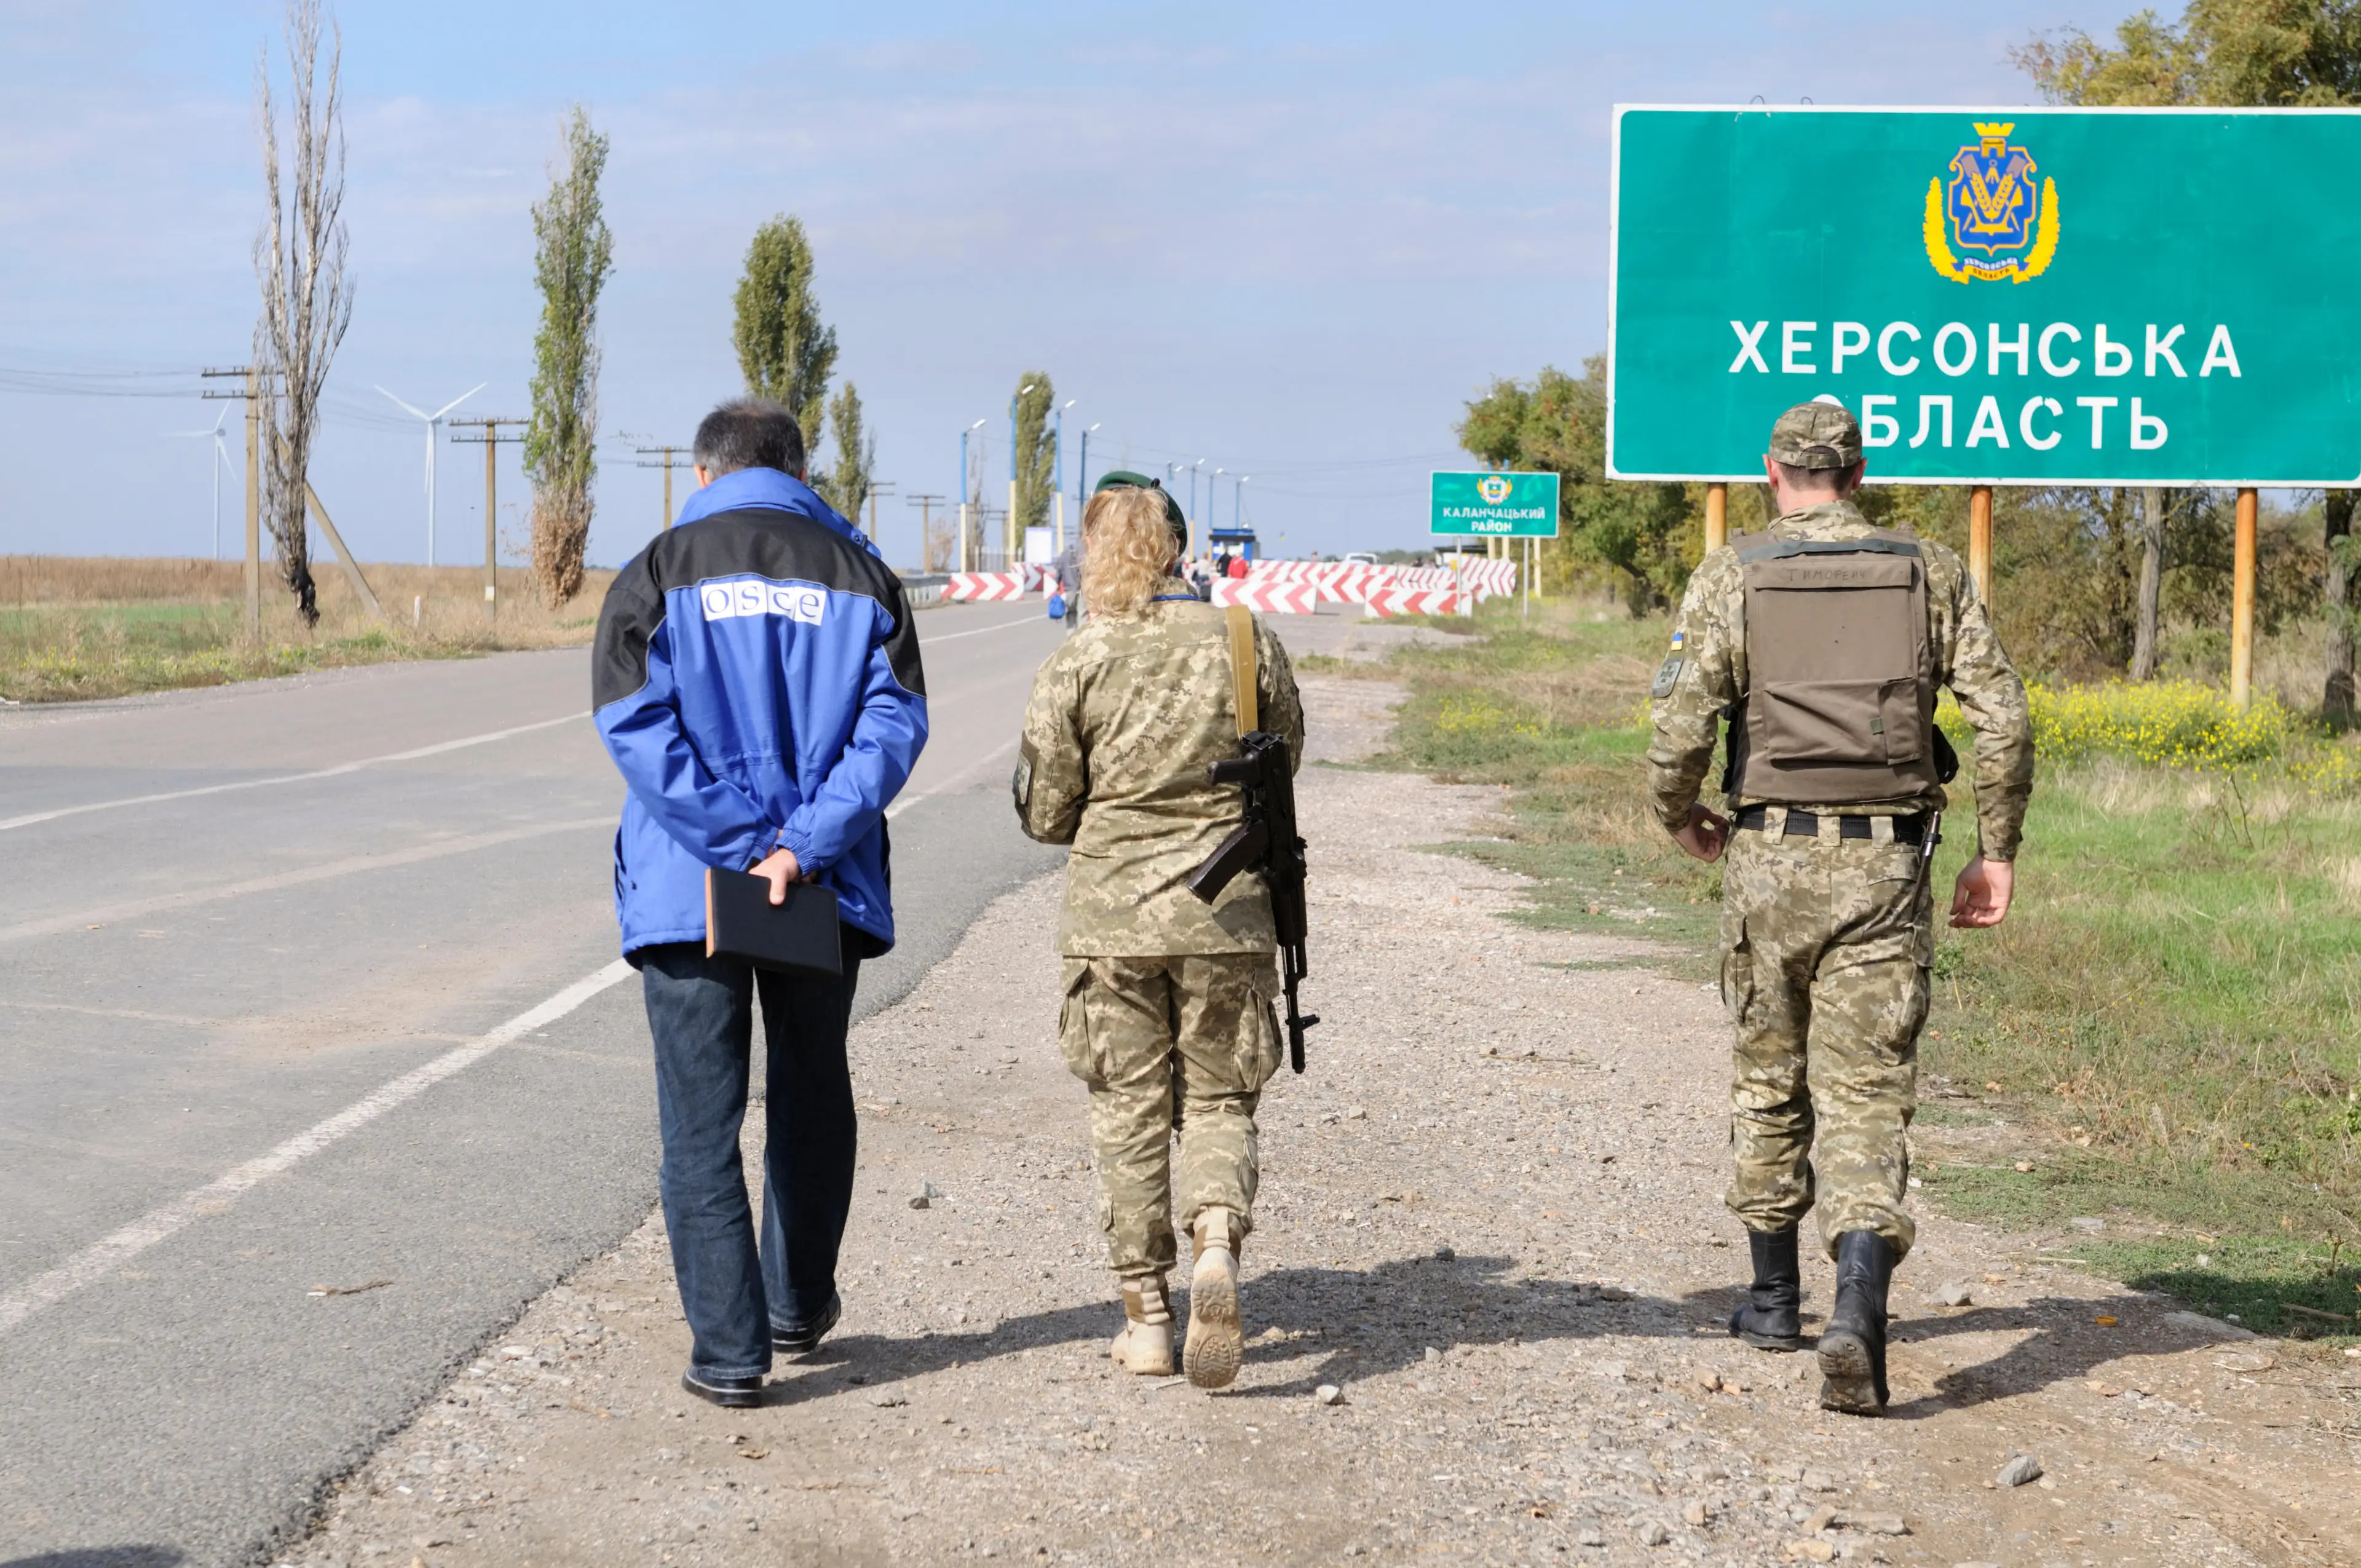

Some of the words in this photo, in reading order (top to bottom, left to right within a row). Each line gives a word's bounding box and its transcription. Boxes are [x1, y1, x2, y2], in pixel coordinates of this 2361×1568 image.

[1728, 320, 2242, 378] ХЕРСОНСЬКА
[1811, 394, 2168, 451] БЛАСТЬ
[1442, 506, 1545, 520] КАЛАНЧАЦЬКИЙ
[1471, 518, 1513, 533] РАЙОН
